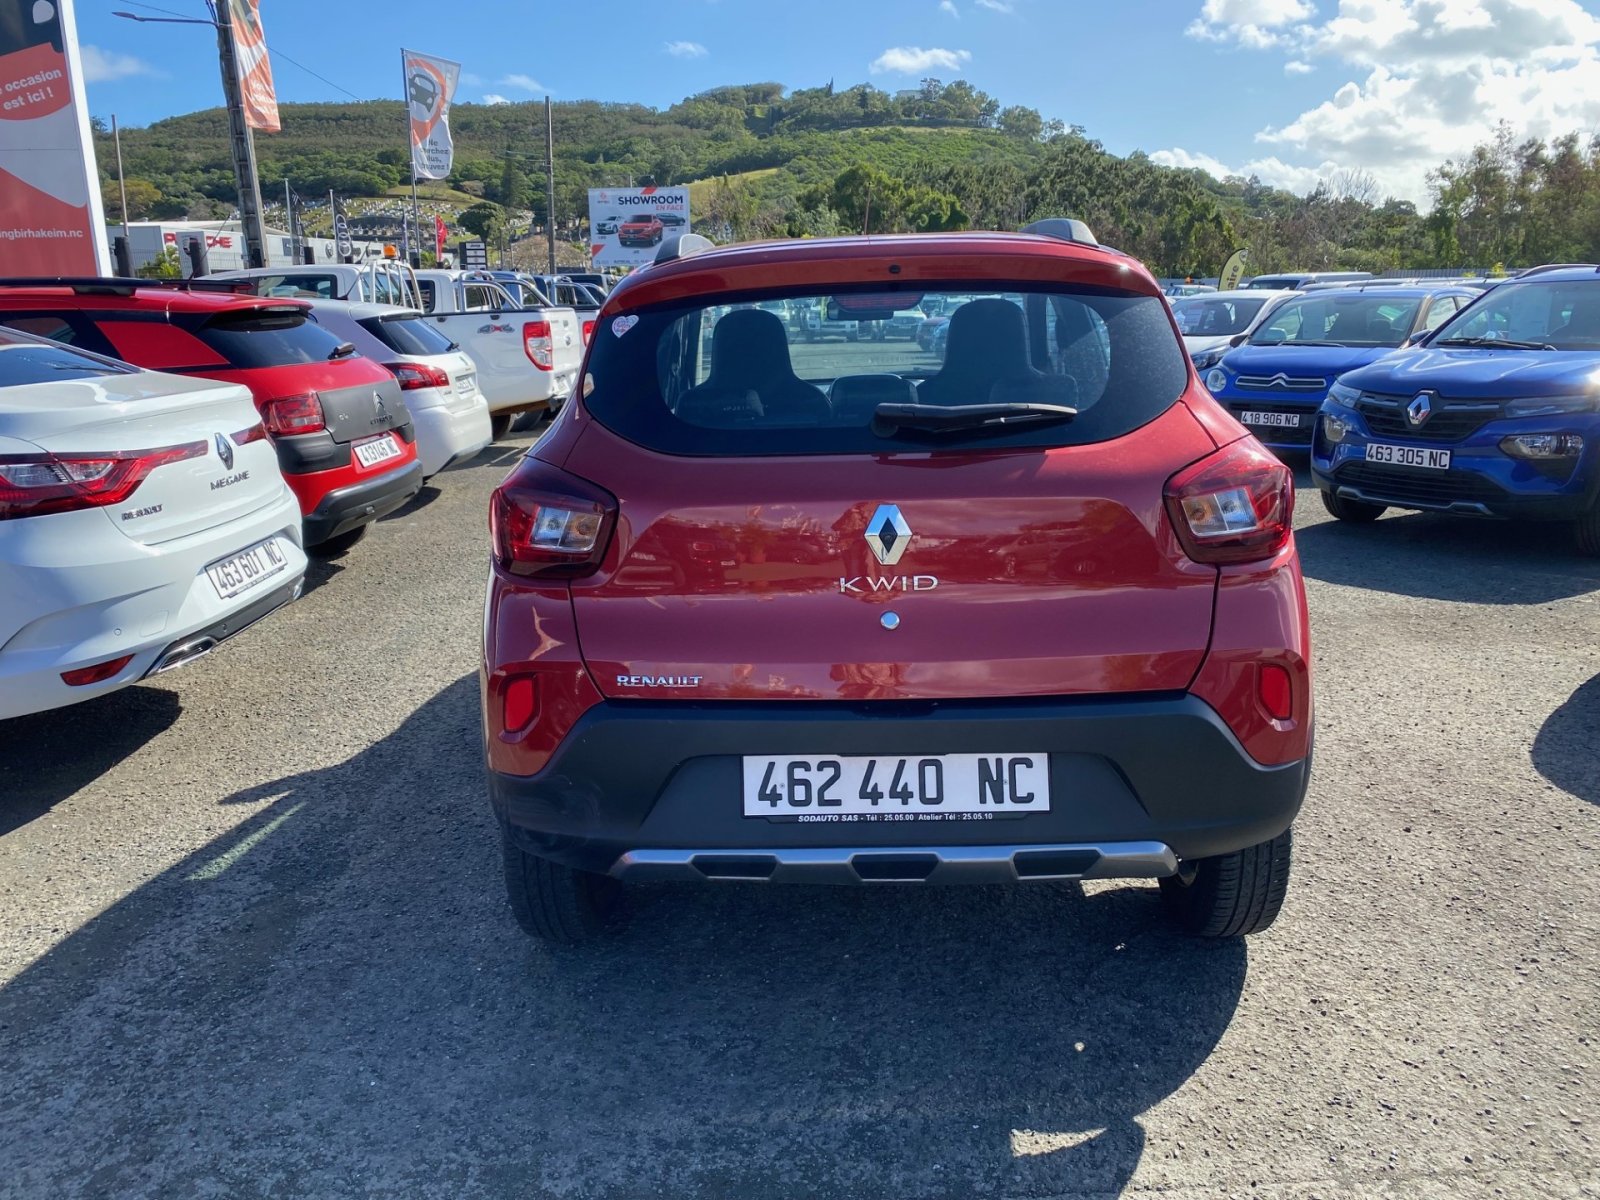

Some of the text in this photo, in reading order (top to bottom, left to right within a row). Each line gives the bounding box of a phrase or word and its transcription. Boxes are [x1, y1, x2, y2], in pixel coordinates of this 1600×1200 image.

[5, 69, 62, 92] occasion
[3, 95, 26, 110] est
[26, 88, 46, 104] ici
[618, 195, 684, 206] SHOWROOM
[1242, 412, 1299, 426] 418 906 NC
[1367, 444, 1449, 468] 463 305 NC
[210, 470, 250, 491] MEGANE
[215, 561, 243, 590] 463
[239, 549, 266, 579] 601
[263, 541, 282, 567] NC
[838, 575, 939, 593] KWID
[616, 674, 703, 688] RENAULT
[757, 757, 1036, 808] 462 440 NC
[798, 814, 839, 822] SODAUTO
[841, 814, 859, 822] SAS
[918, 813, 942, 821] Atelier
